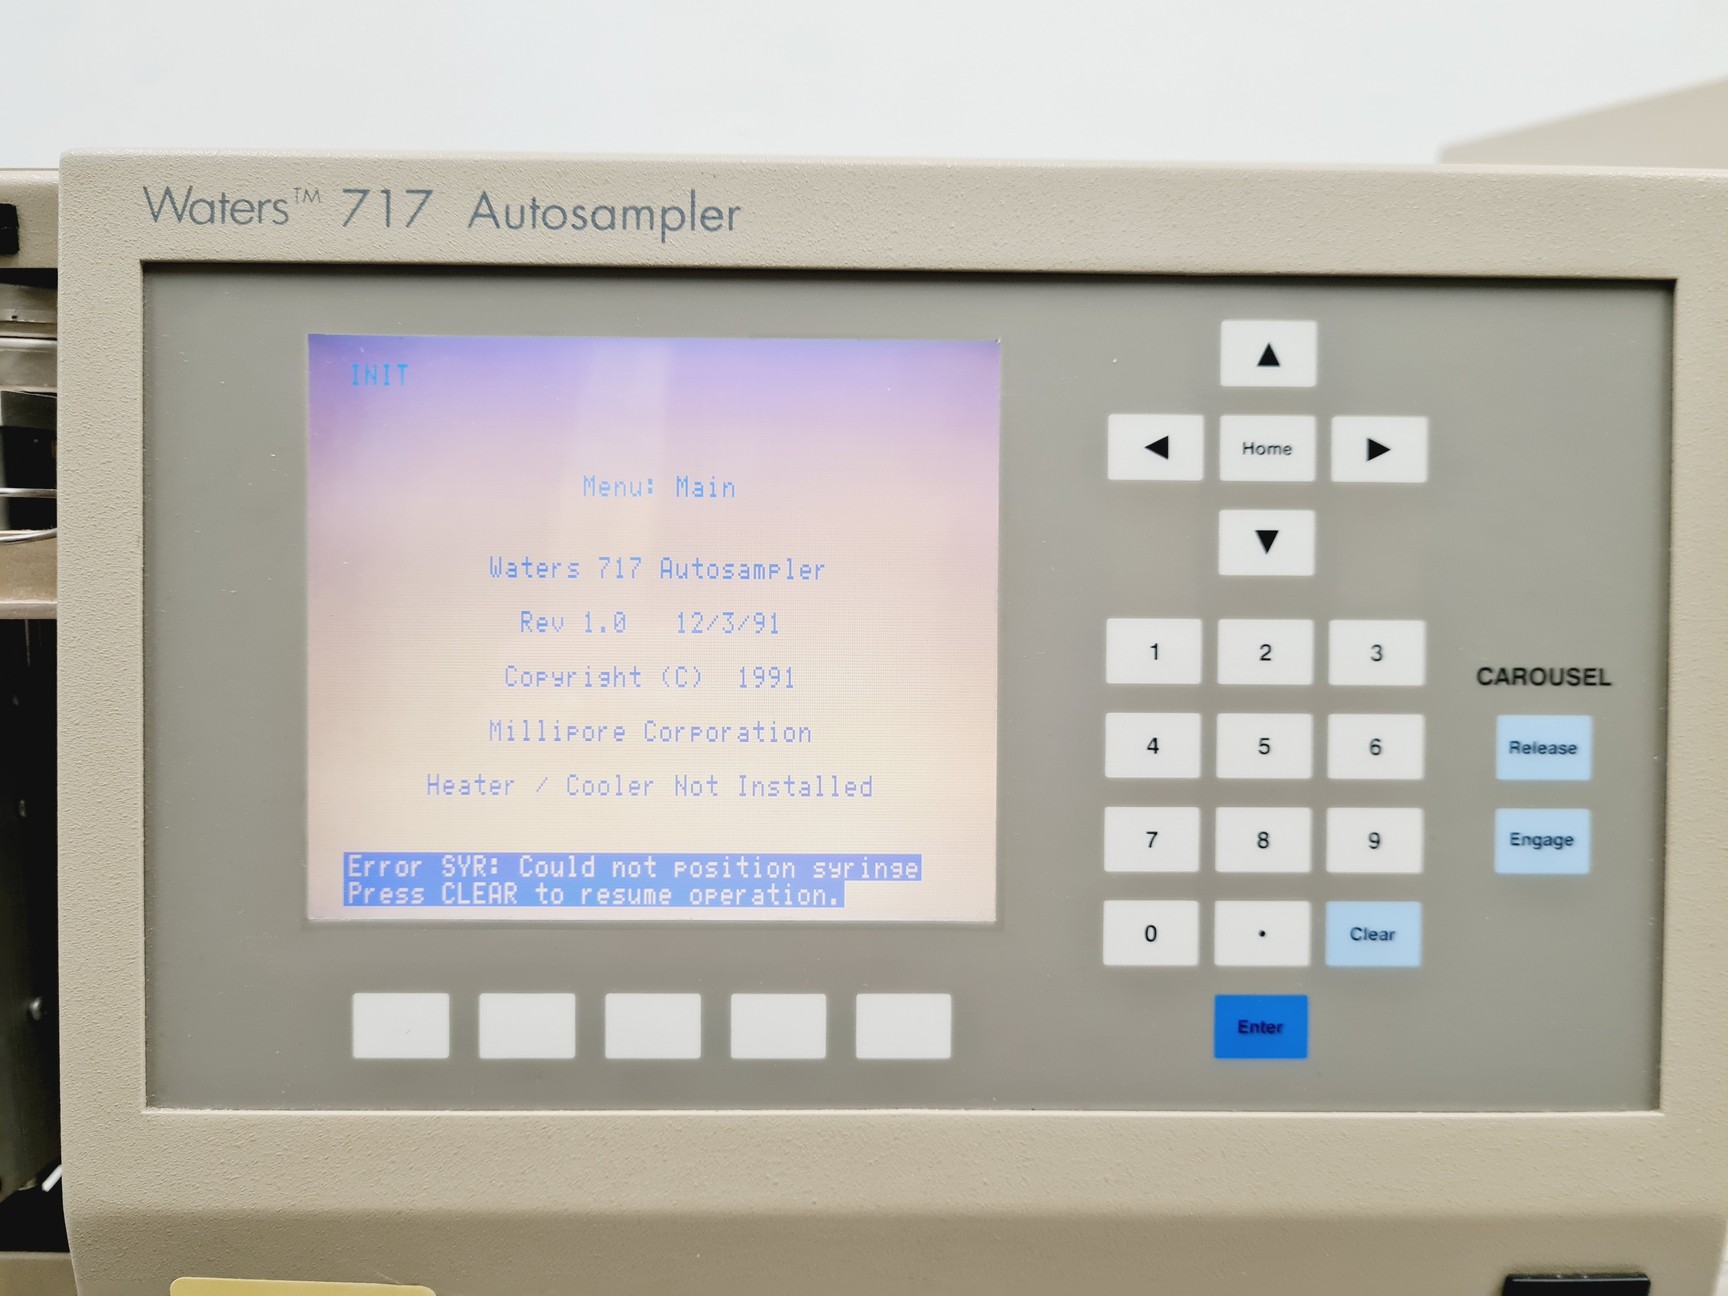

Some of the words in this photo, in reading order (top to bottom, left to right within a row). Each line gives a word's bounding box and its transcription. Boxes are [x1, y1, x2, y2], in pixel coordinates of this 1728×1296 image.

[341, 189, 434, 229] 717
[468, 190, 742, 244] Autosampler
[350, 363, 409, 387] INIT
[1241, 441, 1293, 457] Home
[582, 476, 656, 499] Menu:
[675, 476, 736, 499] Main
[489, 556, 580, 580] Waters
[598, 557, 642, 580] 717
[660, 557, 826, 581] Autosampler
[520, 612, 565, 634] Rev
[584, 612, 627, 634] 1.0
[675, 612, 779, 635] 12/3/91
[1149, 644, 1160, 661] 1
[1259, 644, 1273, 662] 2
[1369, 644, 1383, 663] 3
[504, 666, 642, 689] Copyright
[661, 666, 702, 689] (C)
[738, 667, 795, 689] 1991
[1476, 667, 1612, 687] CAROUSEL
[489, 720, 626, 743] Millipore
[643, 720, 811, 744] Corporation
[1146, 738, 1160, 755] 4
[1257, 738, 1271, 756] 5
[1368, 738, 1382, 756] 6
[1508, 739, 1578, 756] Release
[426, 774, 515, 797] Heater
[535, 776, 548, 794] /
[566, 775, 654, 798] Cooler
[674, 775, 718, 798] Not
[738, 775, 873, 798] Installed
[1145, 831, 1158, 849] 7
[1257, 831, 1270, 850] 8
[1368, 832, 1381, 850] 9
[1509, 832, 1574, 851] Engage
[347, 856, 422, 878] Error
[441, 856, 501, 878] SYR:
[519, 856, 596, 879] Could
[612, 856, 656, 879] not
[674, 857, 795, 880] position
[812, 857, 919, 880] syringe
[348, 882, 424, 905] Press
[441, 882, 517, 905] CLEAR
[535, 883, 565, 906] to
[581, 884, 672, 906] resume
[689, 884, 840, 906] operation.
[1144, 925, 1157, 943] 0
[1349, 926, 1396, 942] Clear
[1237, 1020, 1284, 1035] Enter
